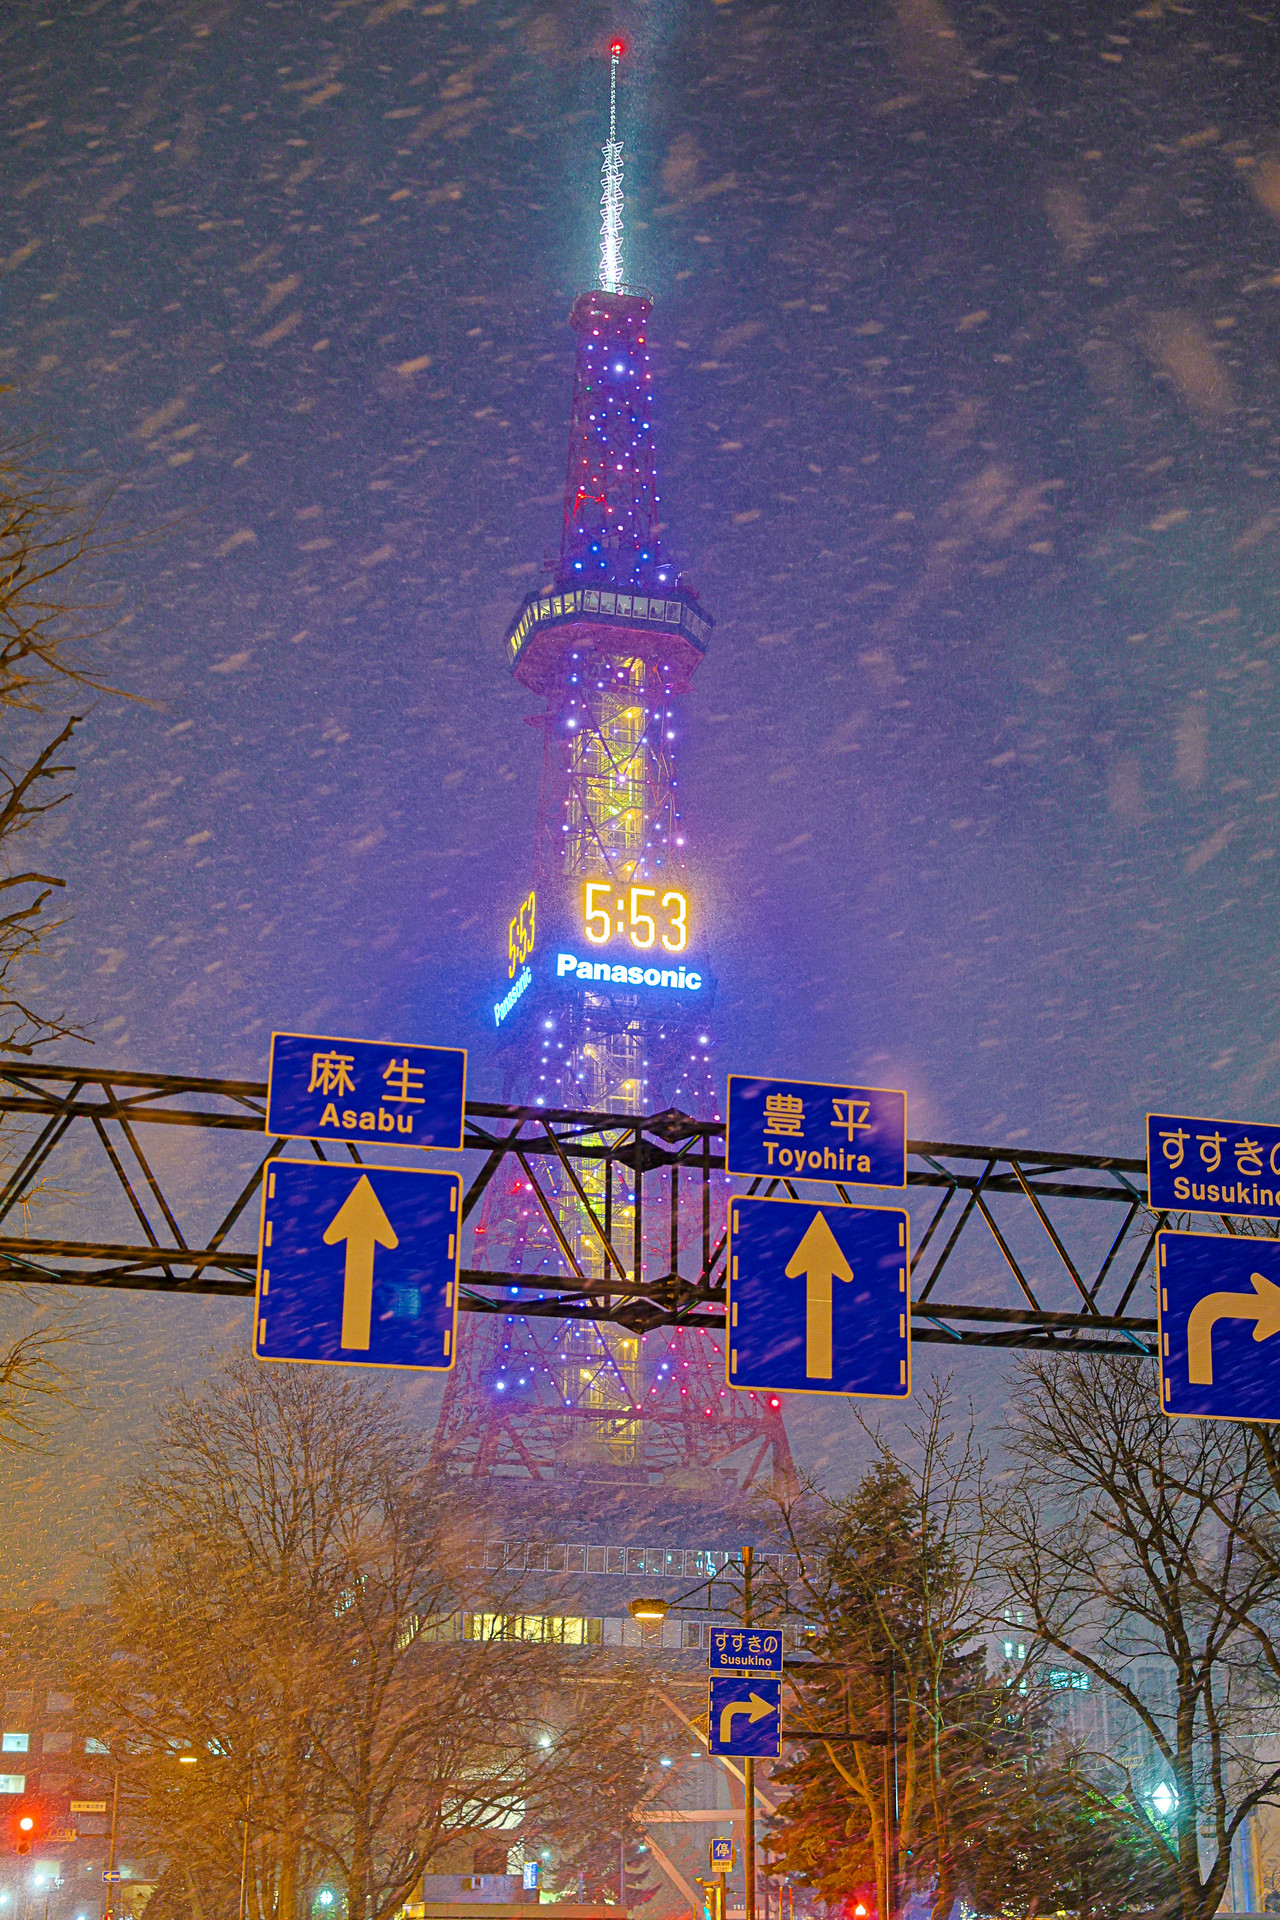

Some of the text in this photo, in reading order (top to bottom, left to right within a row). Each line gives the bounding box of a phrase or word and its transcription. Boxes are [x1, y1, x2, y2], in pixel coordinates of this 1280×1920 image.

[508, 891, 535, 979] 5:53
[584, 881, 688, 953] 5:53
[556, 953, 702, 990] Panasonic
[493, 965, 532, 1027] Panasonic
[307, 1050, 426, 1104] 麻生
[319, 1103, 413, 1133] Asabu
[763, 1093, 872, 1142] 豊平
[763, 1141, 871, 1173] Toyohira
[714, 1632, 778, 1653] すすきの
[720, 1653, 772, 1667] Susukino
[715, 1843, 730, 1857] 停
